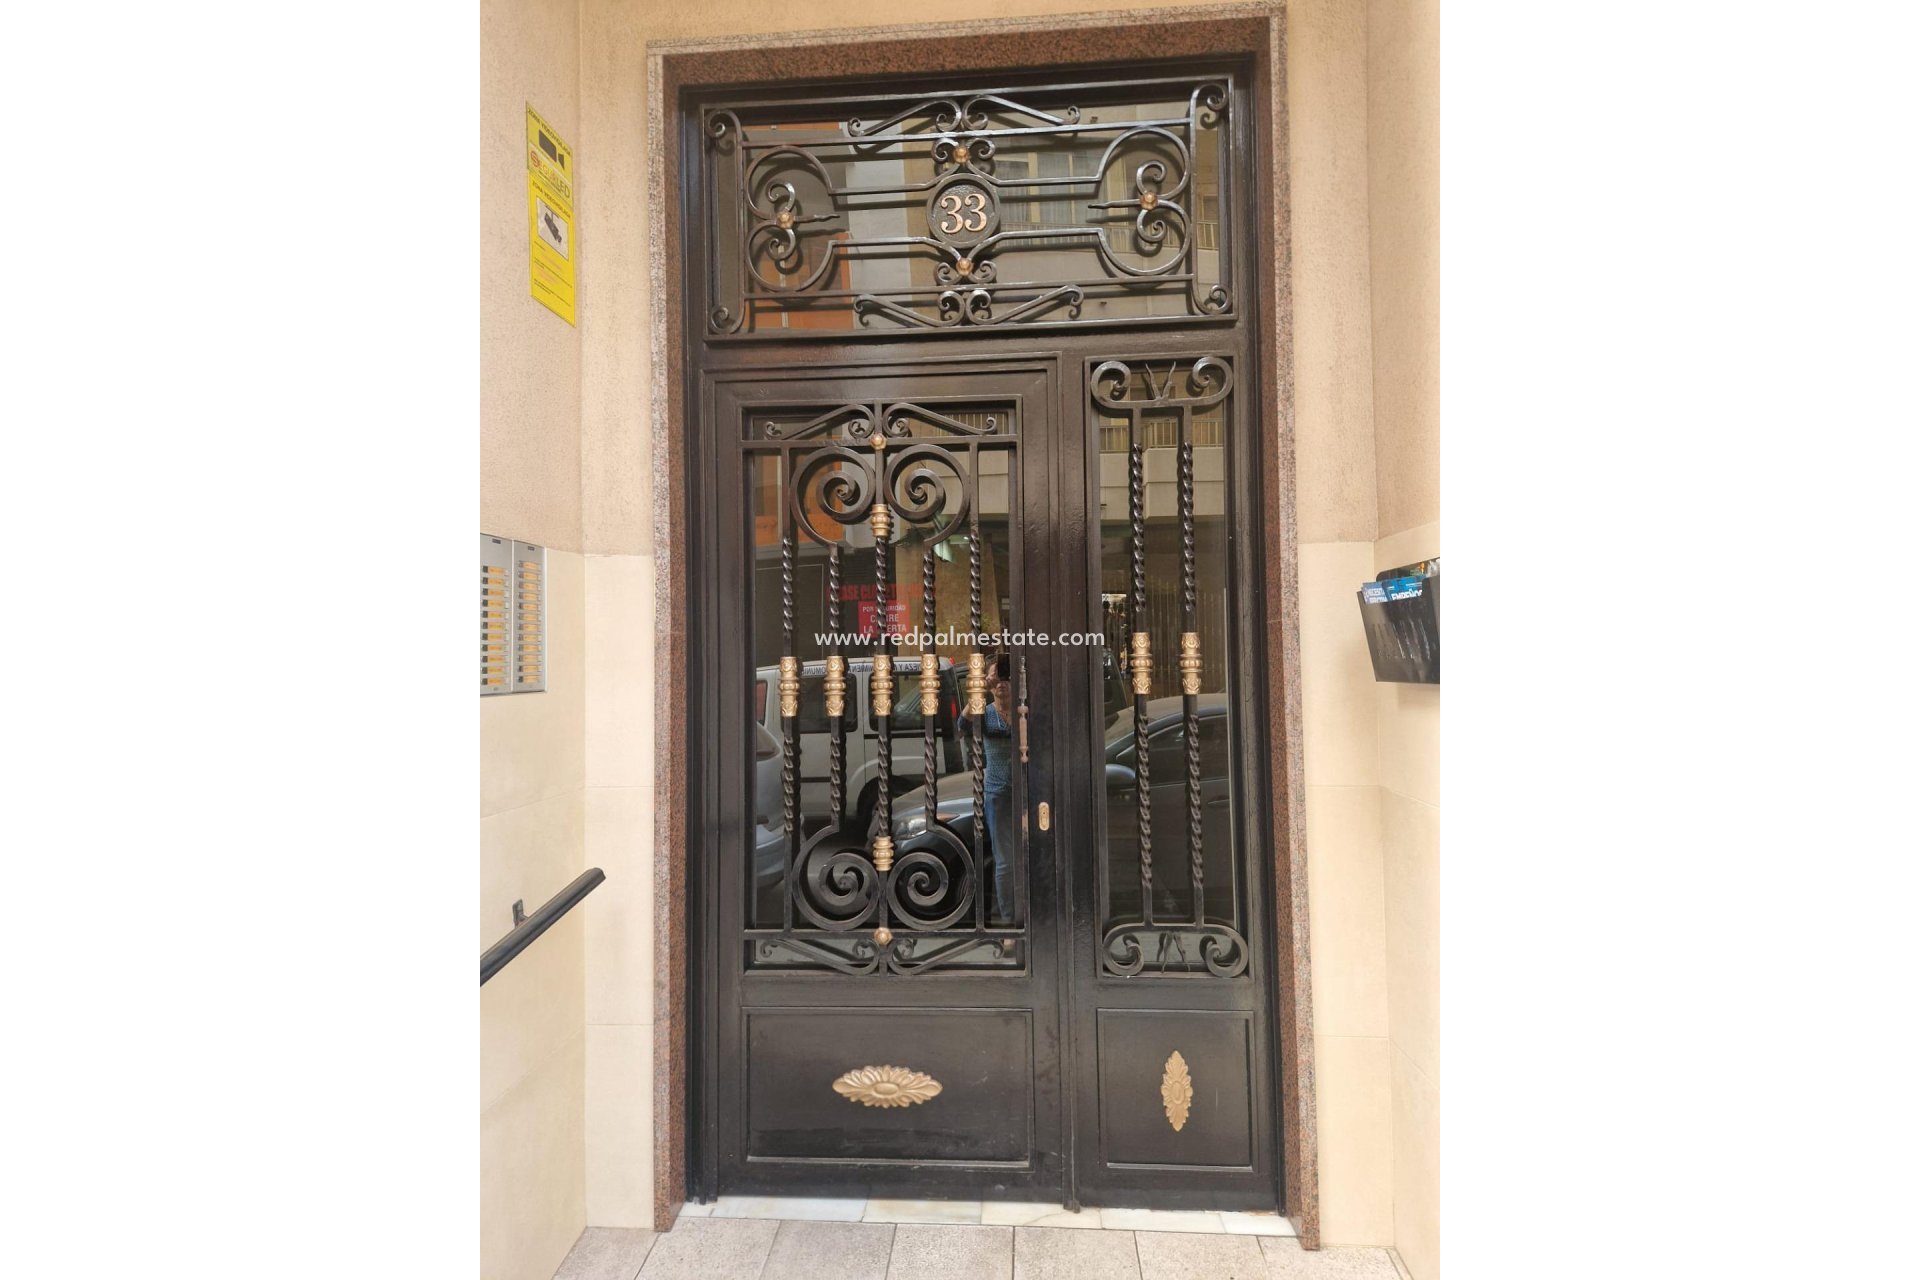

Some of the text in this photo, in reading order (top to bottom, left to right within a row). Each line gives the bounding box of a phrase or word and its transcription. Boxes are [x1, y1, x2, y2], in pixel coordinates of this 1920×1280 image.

[941, 193, 987, 234] 33
[863, 624, 907, 634] LA ERTA
